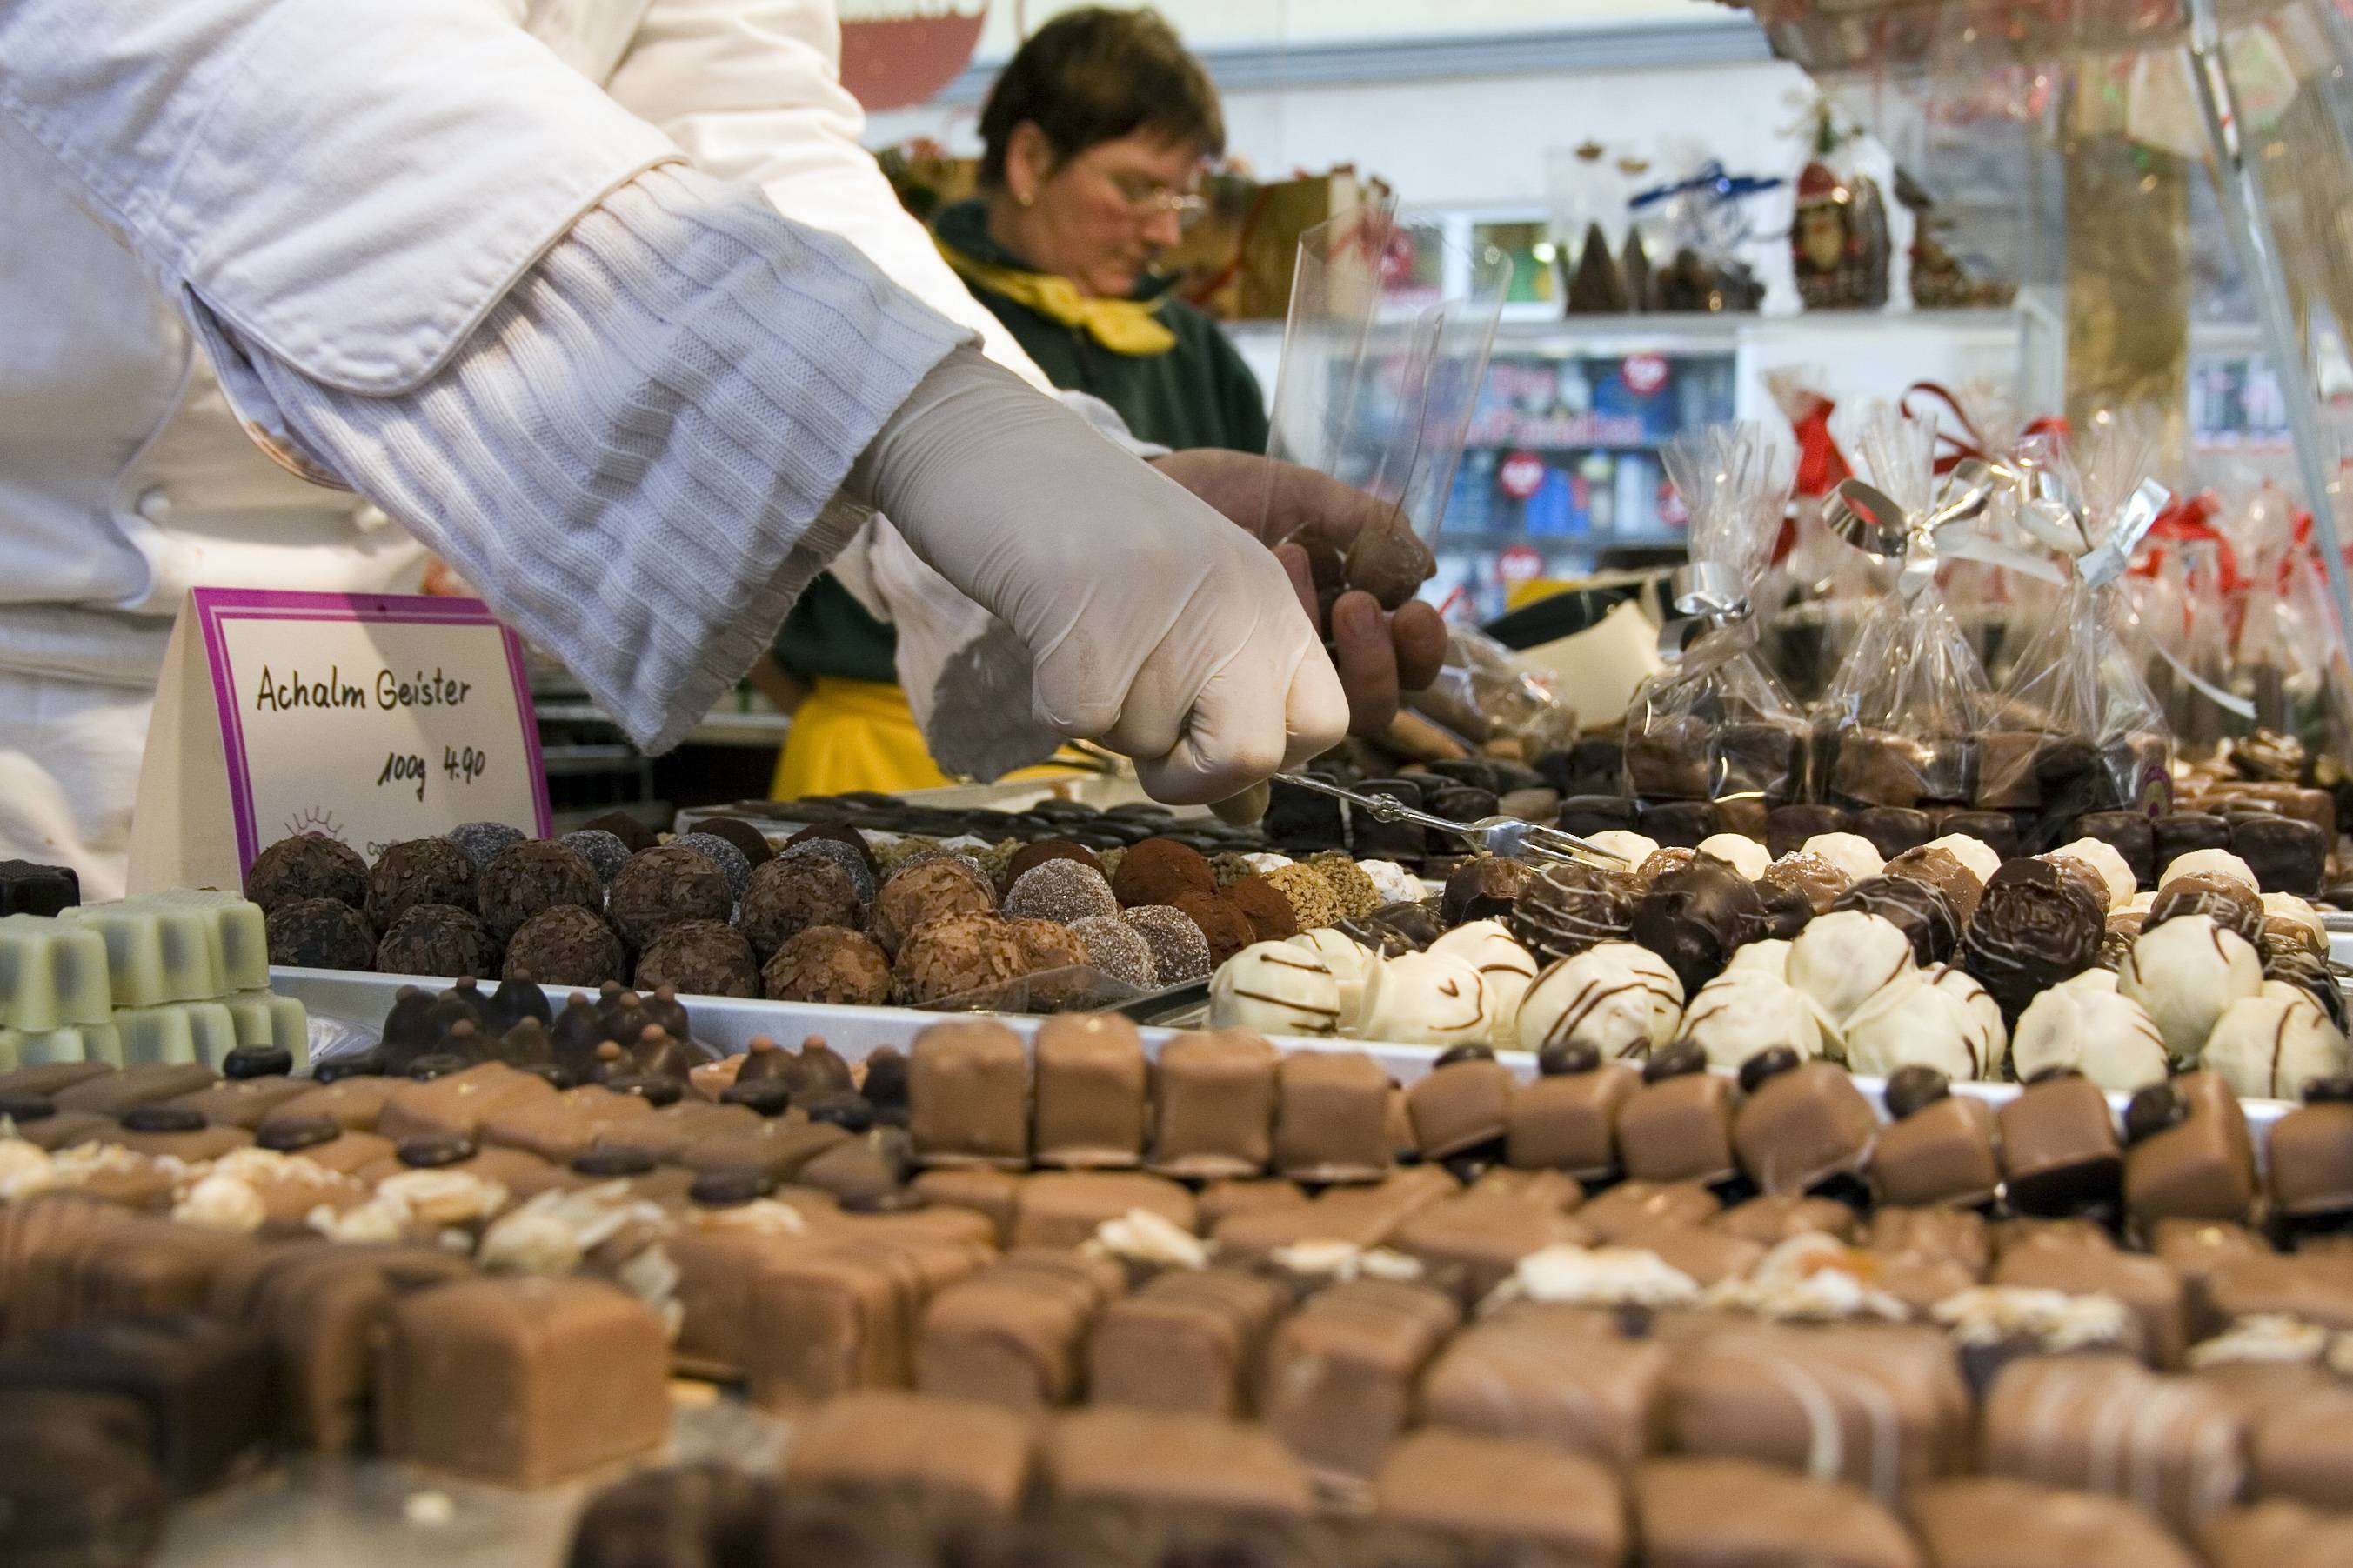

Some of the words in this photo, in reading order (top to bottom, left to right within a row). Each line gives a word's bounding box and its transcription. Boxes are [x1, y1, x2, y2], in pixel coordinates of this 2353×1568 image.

[257, 664, 366, 711] Achalm
[376, 666, 471, 711] Geister
[377, 751, 426, 802] 100g
[443, 745, 485, 784] 4.90
